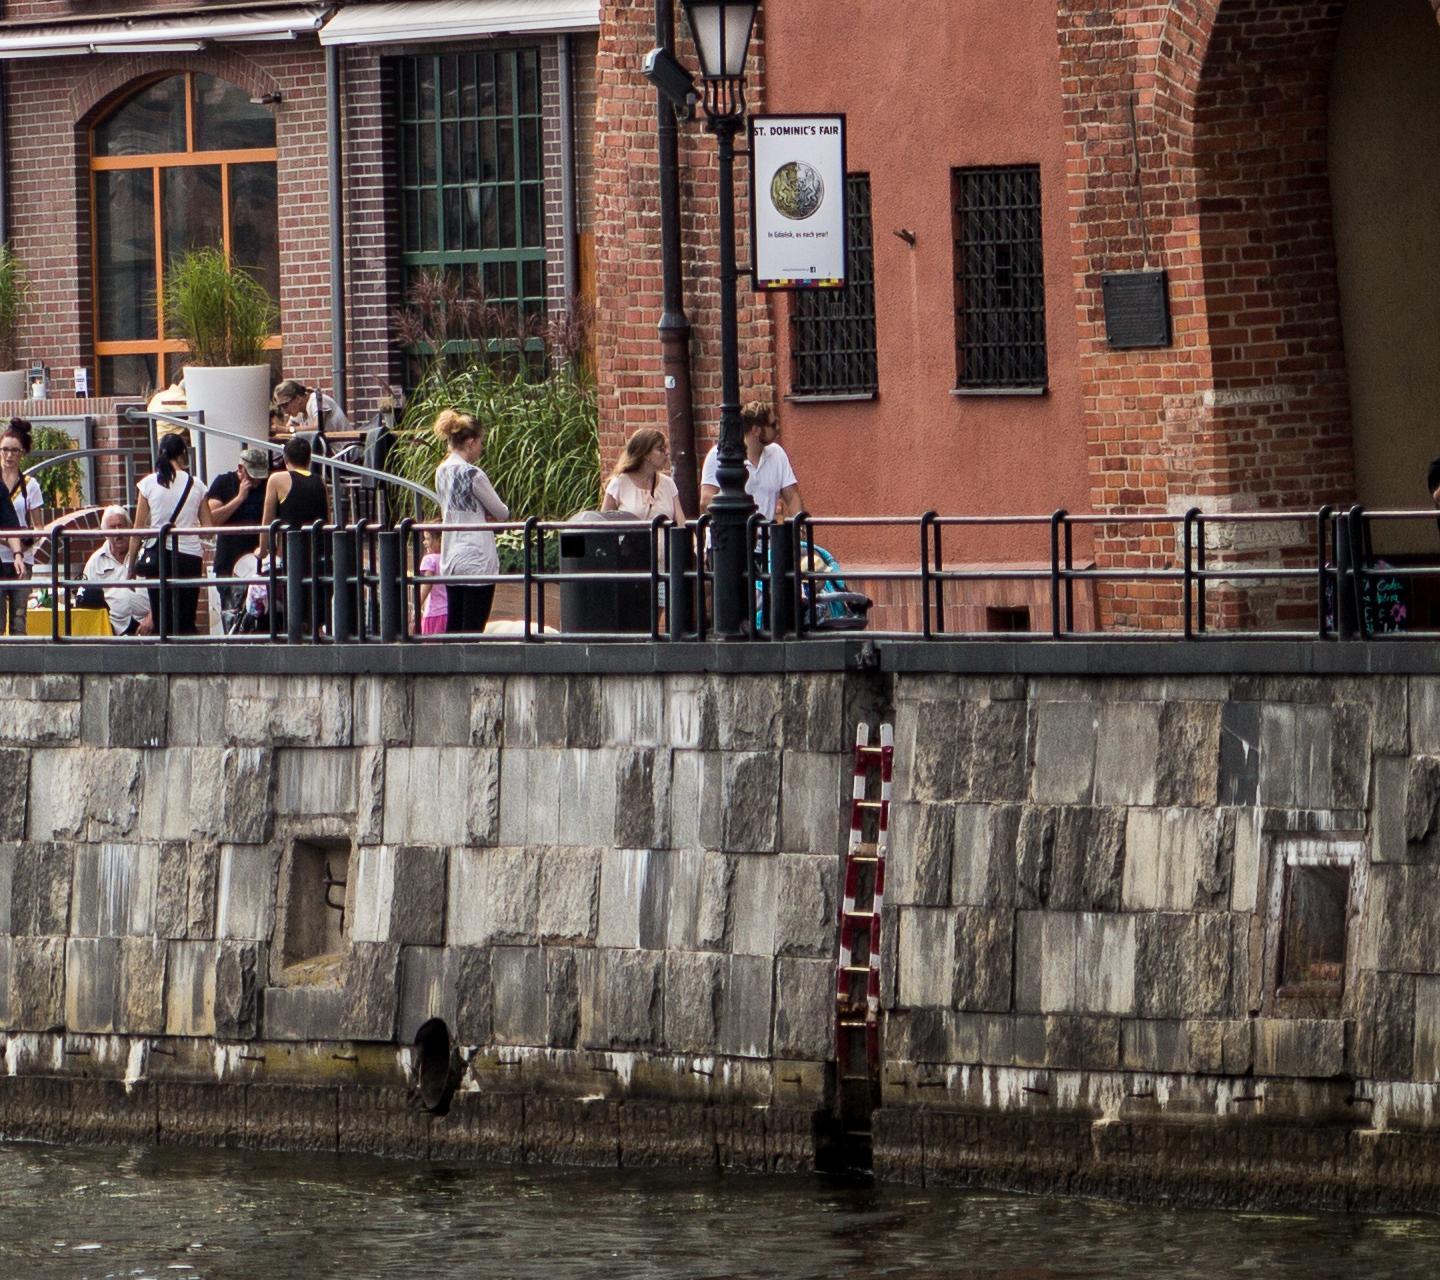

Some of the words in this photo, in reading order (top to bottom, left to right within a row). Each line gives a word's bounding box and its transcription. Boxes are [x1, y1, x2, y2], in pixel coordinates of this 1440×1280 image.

[754, 127, 766, 136] ST.
[770, 126, 816, 135] DOMINIC'S
[819, 126, 839, 135] FAIR
